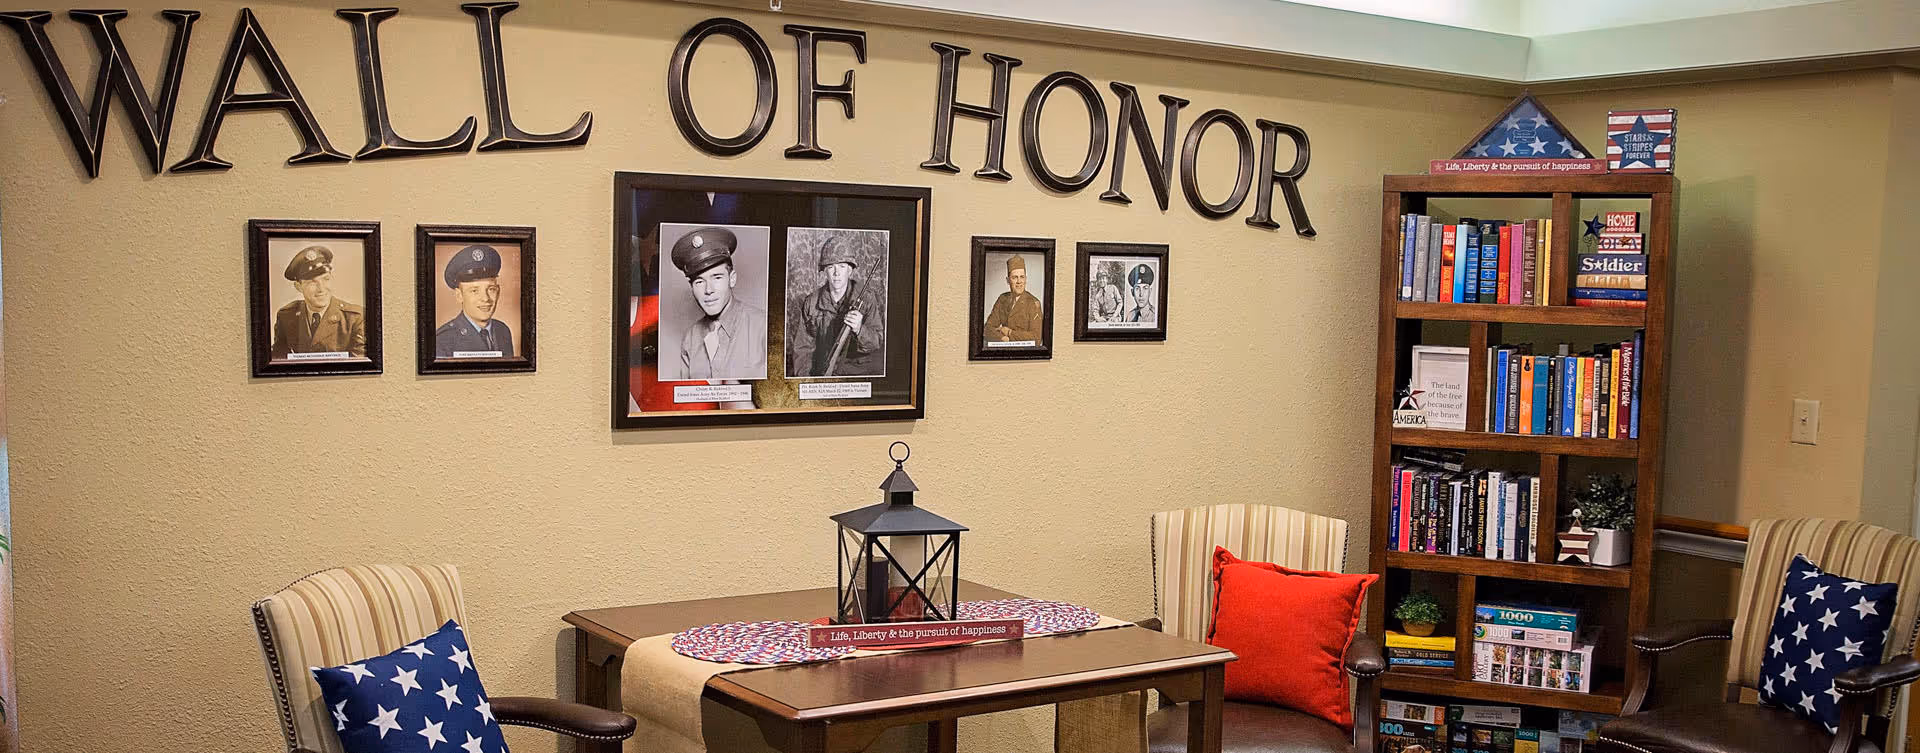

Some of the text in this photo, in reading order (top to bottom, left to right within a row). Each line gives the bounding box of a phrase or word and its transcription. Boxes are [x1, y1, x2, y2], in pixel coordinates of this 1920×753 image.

[0, 1, 1317, 237] WALL OF HONOR
[1624, 143, 1653, 151] STRIPES
[1445, 163, 1461, 171] Life,
[1463, 163, 1489, 171] Liberty
[1513, 163, 1540, 171] pursuit
[1542, 162, 1550, 170] of
[1552, 162, 1590, 171] happiness
[1607, 215, 1635, 227] HOME
[1622, 347, 1632, 375] Mysteries
[1622, 382, 1631, 391] the
[1621, 392, 1630, 407] Bible
[1393, 411, 1426, 424] AMERICA
[1499, 611, 1534, 622] 1000
[831, 625, 1006, 642] Life, Liberty & the pursuit of happiness
[1476, 662, 1484, 679] ART
